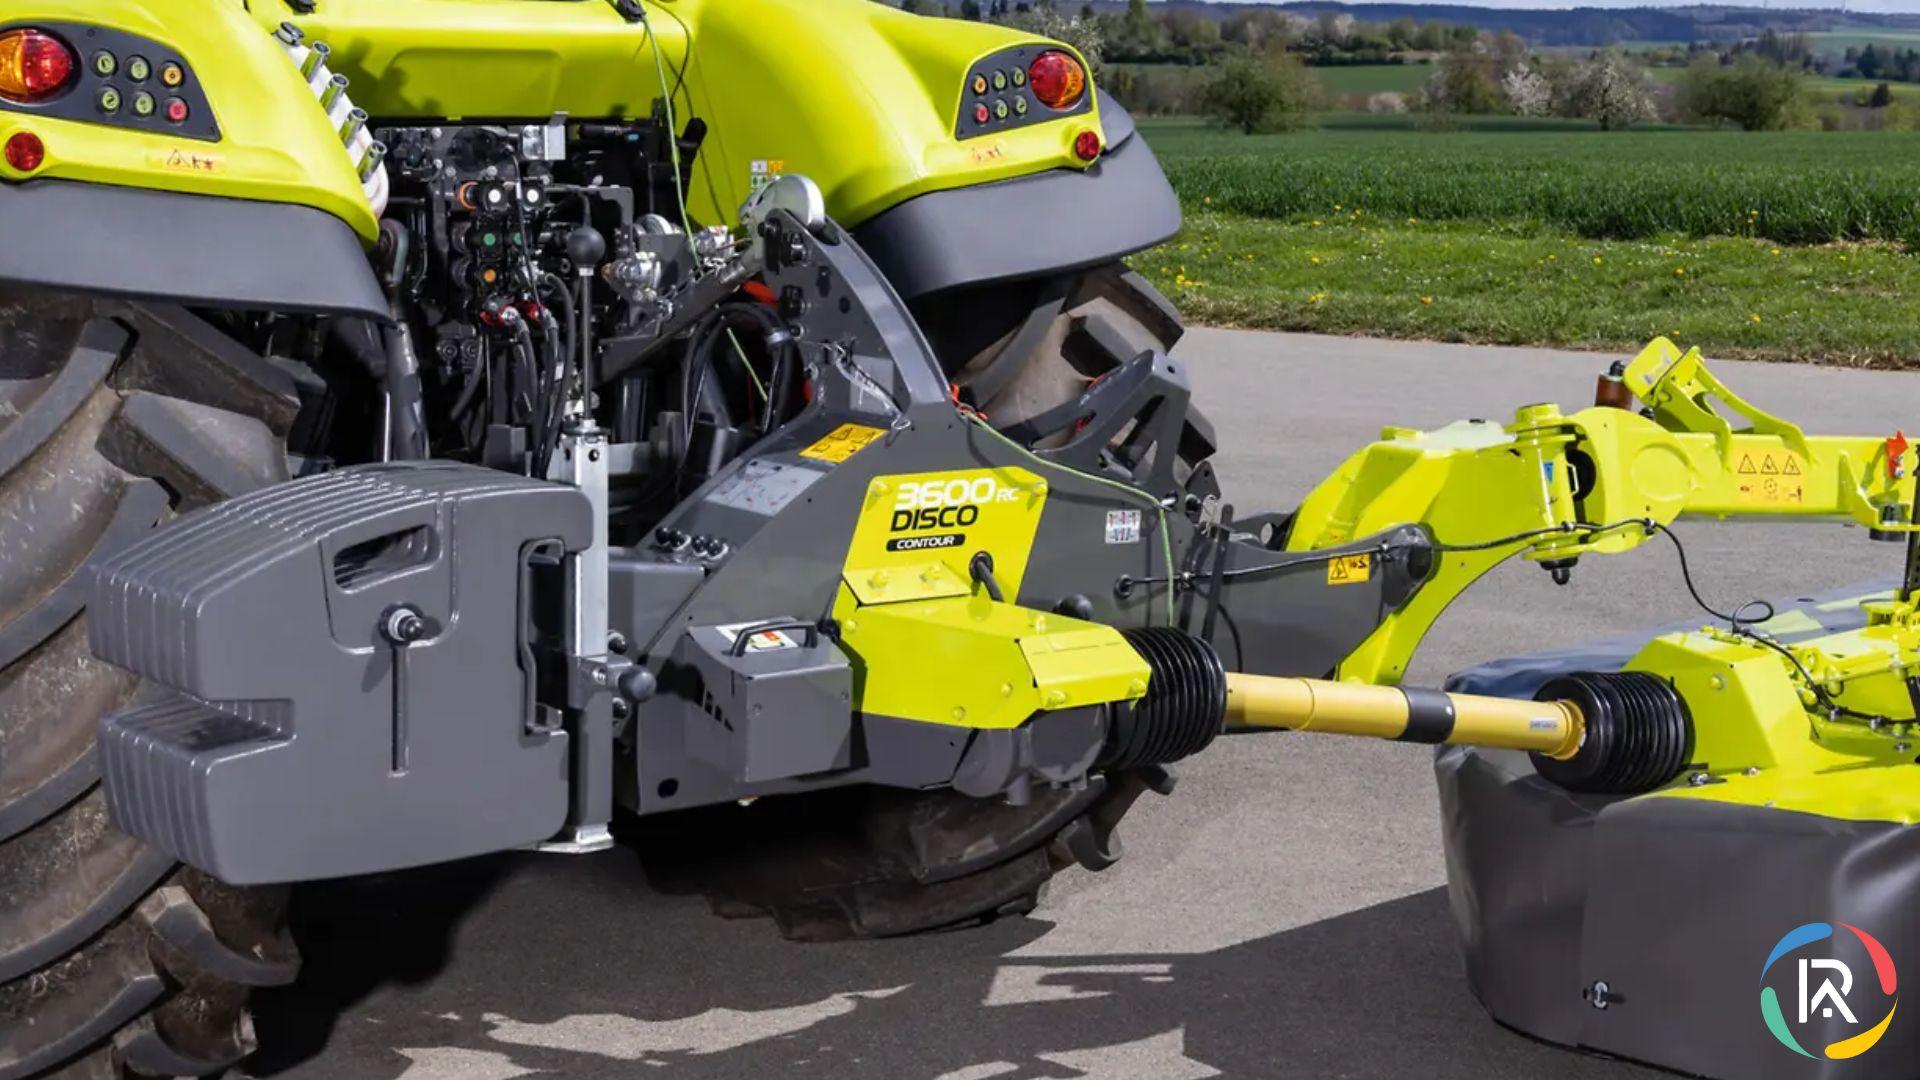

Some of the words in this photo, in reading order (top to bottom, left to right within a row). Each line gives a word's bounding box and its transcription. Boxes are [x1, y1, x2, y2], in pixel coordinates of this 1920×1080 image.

[894, 477, 996, 511] 3600
[996, 487, 1020, 503] RC
[890, 505, 979, 532] DISCO
[896, 535, 955, 550] CONTOUR
